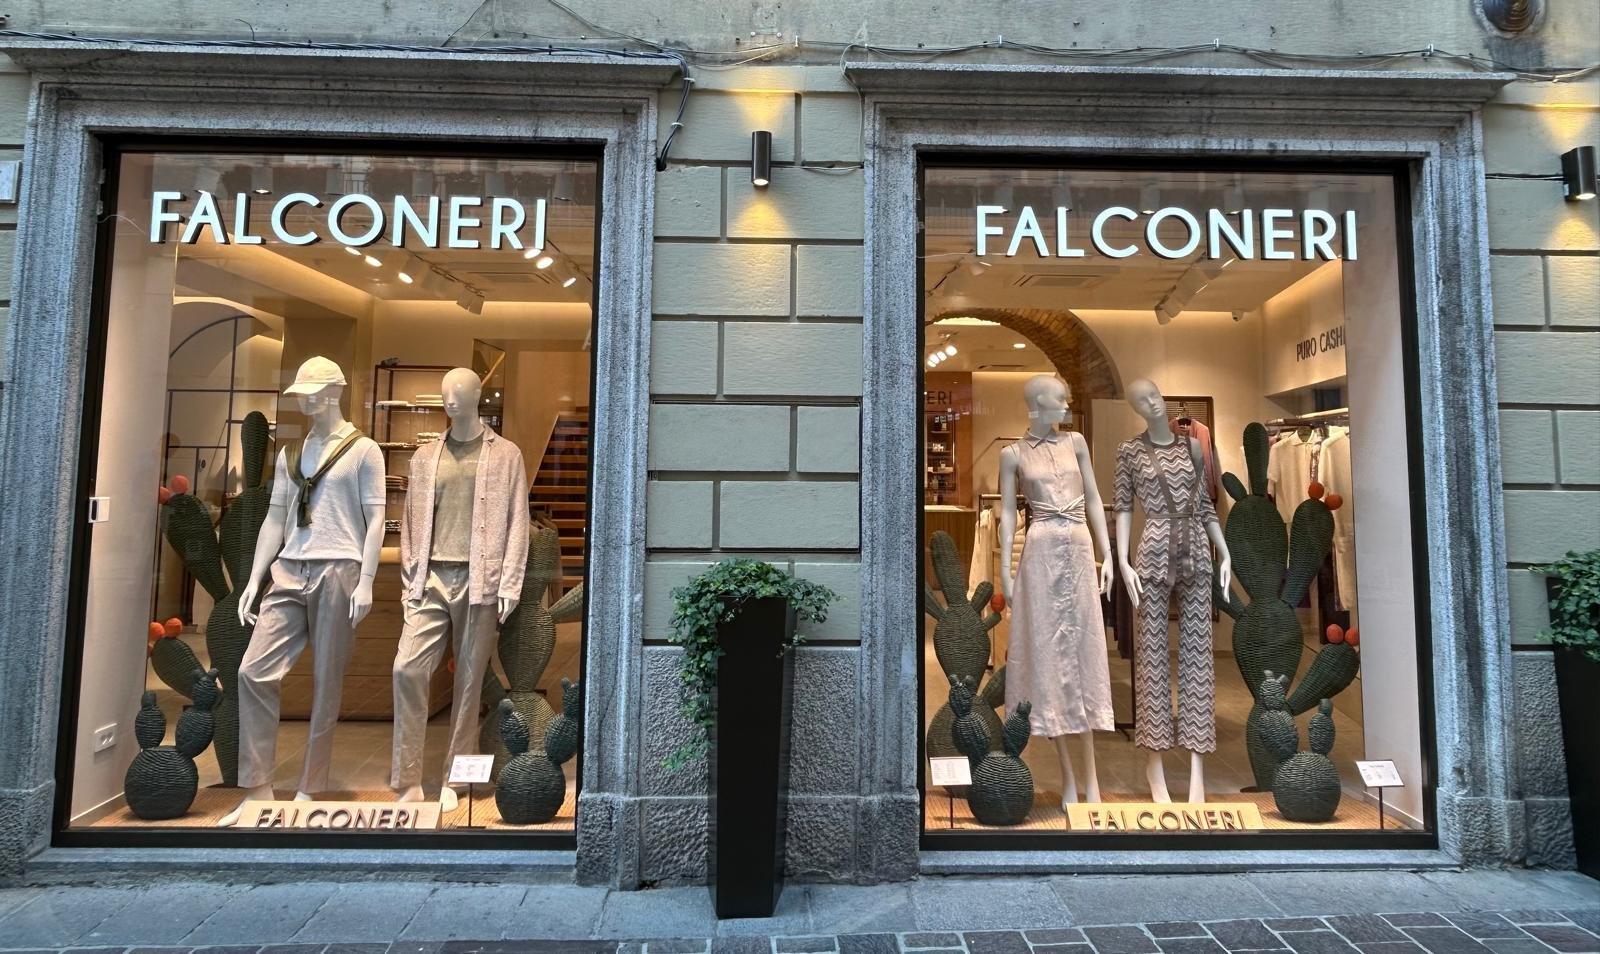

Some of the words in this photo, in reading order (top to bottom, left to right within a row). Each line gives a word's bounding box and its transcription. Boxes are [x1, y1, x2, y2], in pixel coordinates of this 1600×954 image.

[150, 191, 547, 250] FALCONERI
[975, 205, 1358, 261] FALCONERI
[1296, 337, 1317, 362] PURO
[1319, 325, 1346, 353] CASH
